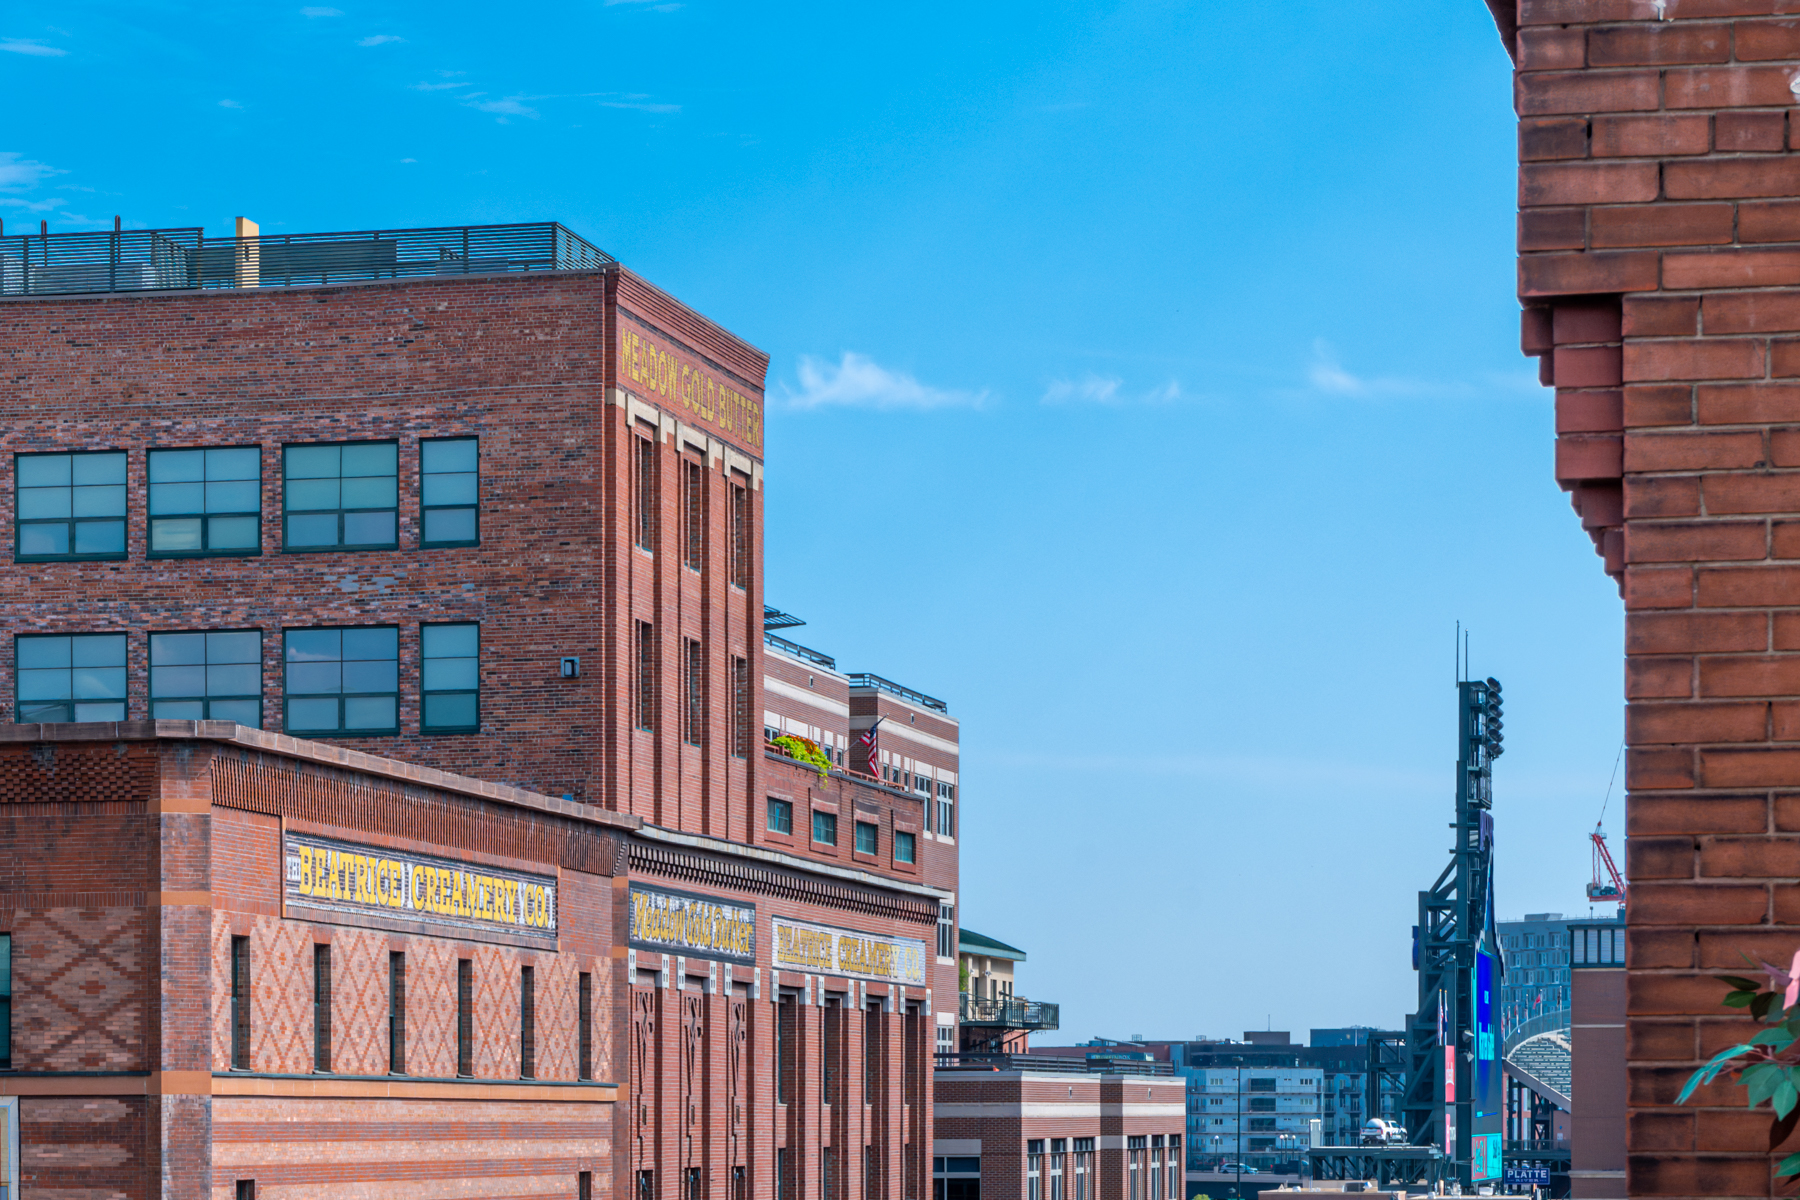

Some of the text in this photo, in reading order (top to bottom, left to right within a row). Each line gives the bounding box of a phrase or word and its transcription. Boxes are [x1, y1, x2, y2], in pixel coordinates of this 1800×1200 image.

[622, 328, 760, 448] MEADOW GOLD BUTTER
[298, 845, 402, 907] BEATRICE
[411, 865, 519, 924] CREAMERY
[632, 892, 753, 953] Meadow Gold Butter
[777, 925, 832, 970] BEATRICE
[838, 935, 901, 978] CREAMERY
[1507, 1170, 1547, 1179] PLATTE
